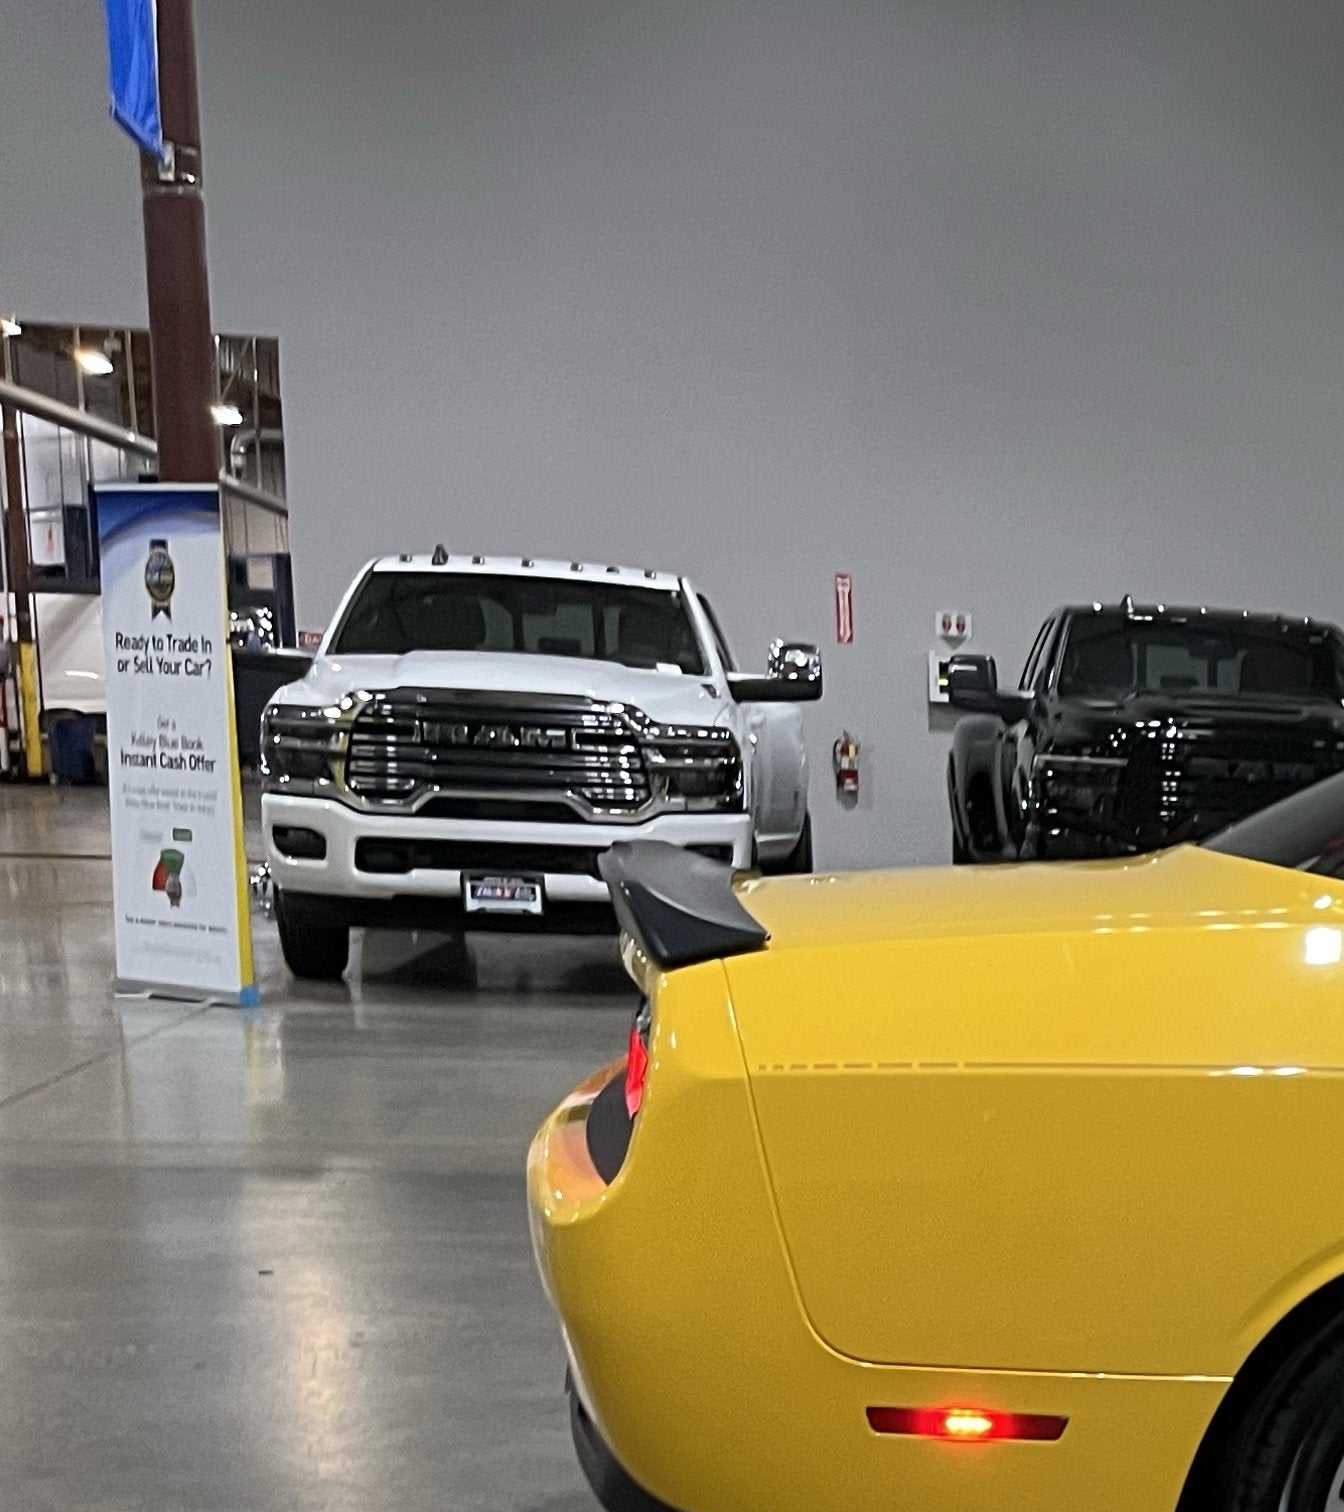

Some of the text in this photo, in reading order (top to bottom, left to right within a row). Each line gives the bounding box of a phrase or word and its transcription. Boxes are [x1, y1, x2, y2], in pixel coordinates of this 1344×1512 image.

[115, 631, 212, 655] Ready to Trade In
[117, 655, 212, 679] or Sell Your Car?
[160, 752, 187, 770] Cash
[189, 754, 216, 773] Offer
